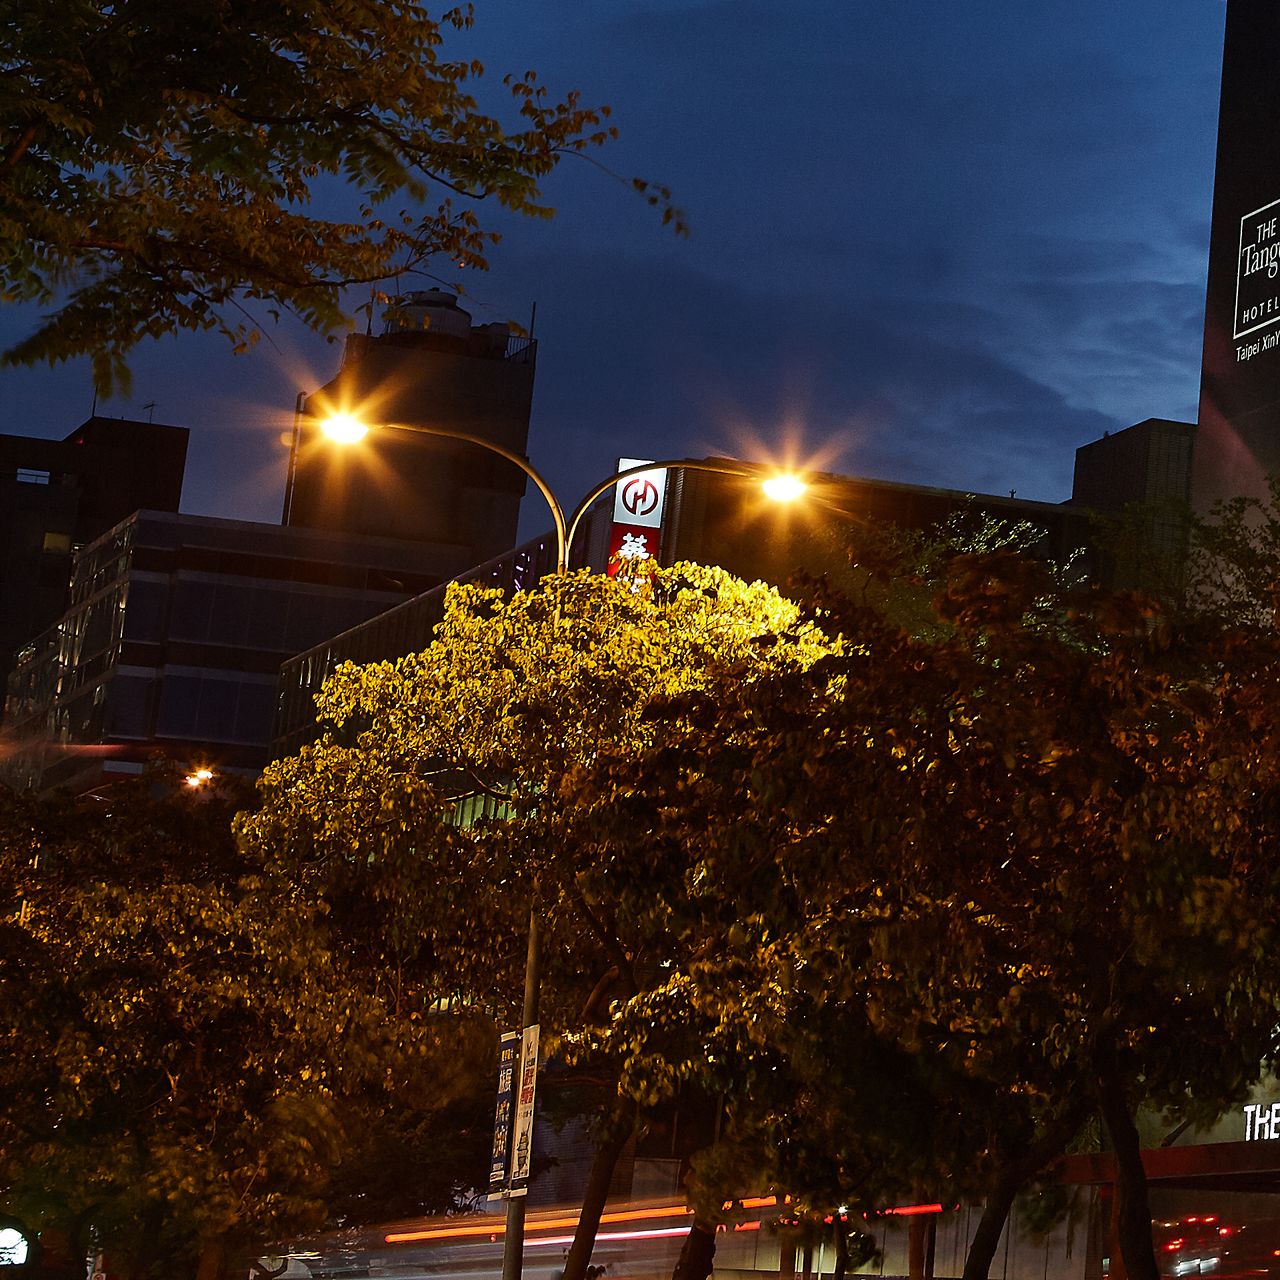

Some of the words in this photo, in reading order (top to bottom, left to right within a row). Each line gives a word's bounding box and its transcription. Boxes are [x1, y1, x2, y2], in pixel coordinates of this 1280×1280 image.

[1256, 217, 1278, 244] THE
[1242, 296, 1280, 324] HOTEL
[1235, 338, 1261, 362] Taipei
